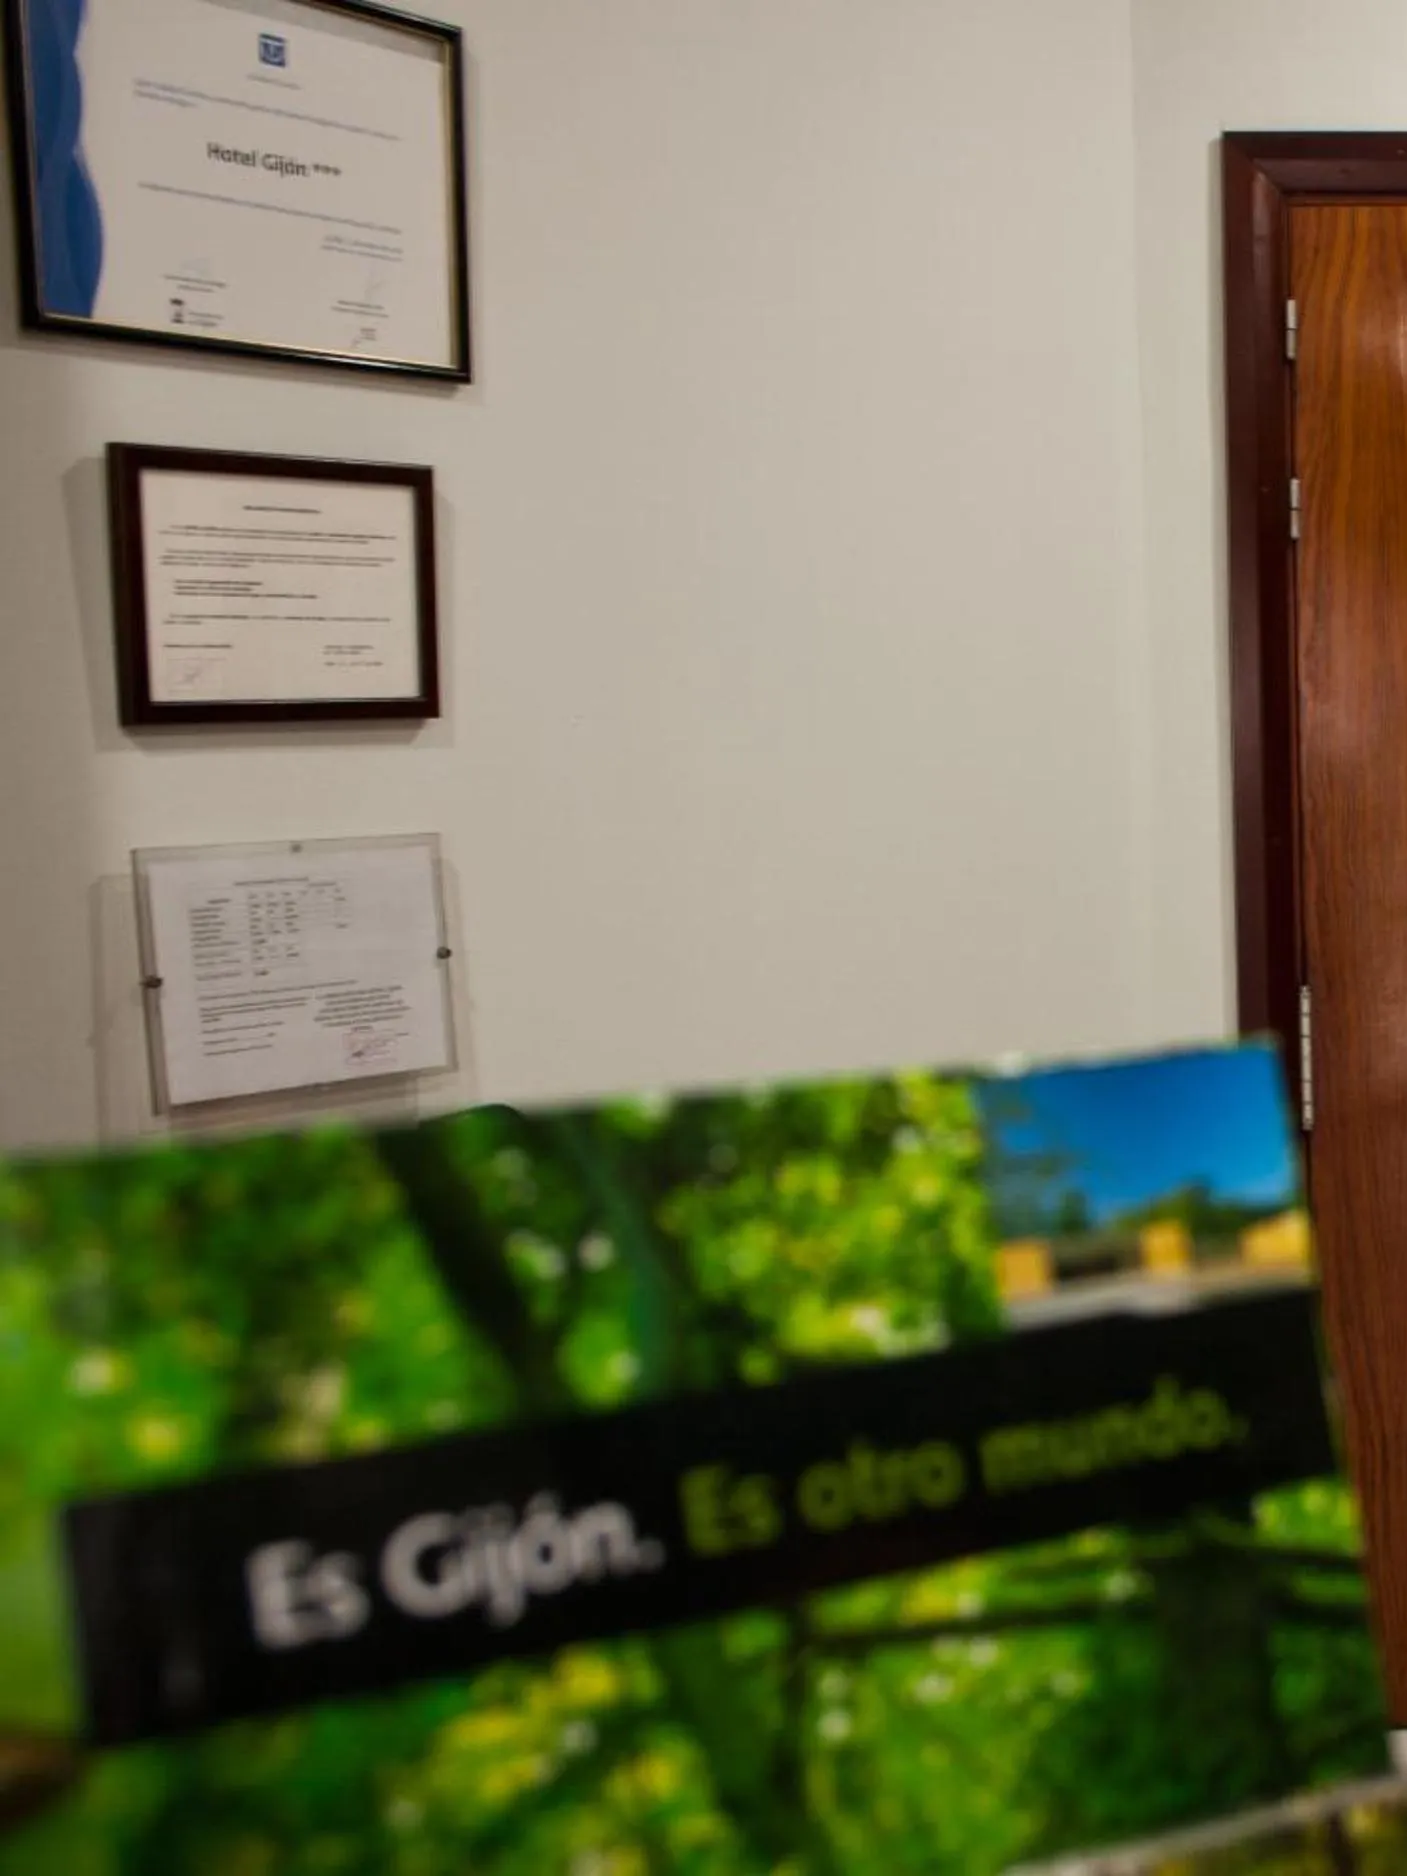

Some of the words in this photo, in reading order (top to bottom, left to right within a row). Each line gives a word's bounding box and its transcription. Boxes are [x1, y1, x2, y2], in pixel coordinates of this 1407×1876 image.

[206, 142, 256, 167] Hotel
[243, 1538, 372, 1651] Es
[380, 1490, 666, 1625] Gijón.
[677, 1463, 782, 1555] Es
[797, 1436, 966, 1531] otro
[977, 1374, 1248, 1497] mundo.
